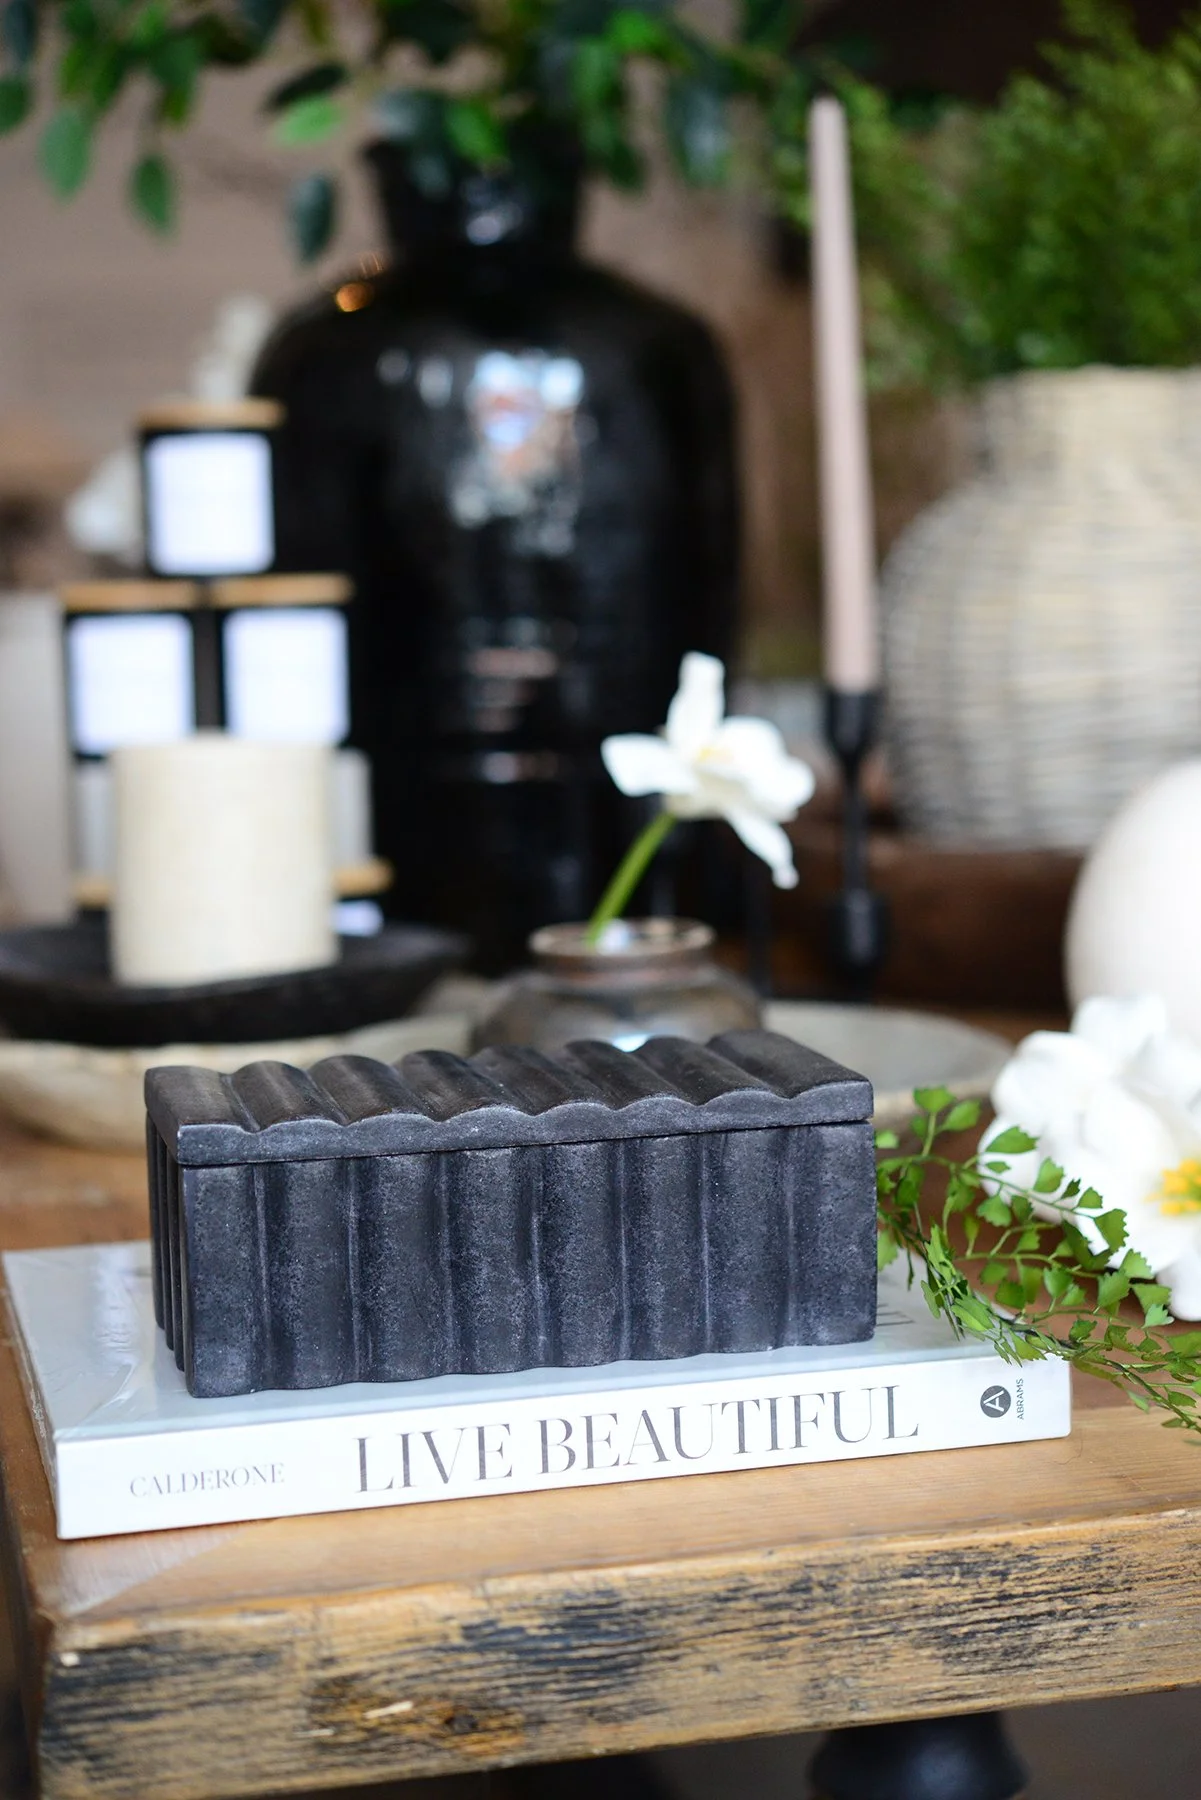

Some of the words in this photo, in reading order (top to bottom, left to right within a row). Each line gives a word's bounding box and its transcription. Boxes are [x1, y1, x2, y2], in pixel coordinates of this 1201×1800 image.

[982, 1389, 1007, 1414] A
[1015, 1377, 1024, 1420] ABRAMS
[352, 1423, 512, 1493] LIVE
[536, 1385, 919, 1474] BEAUTIFUL
[129, 1462, 285, 1497] CALDERONE
